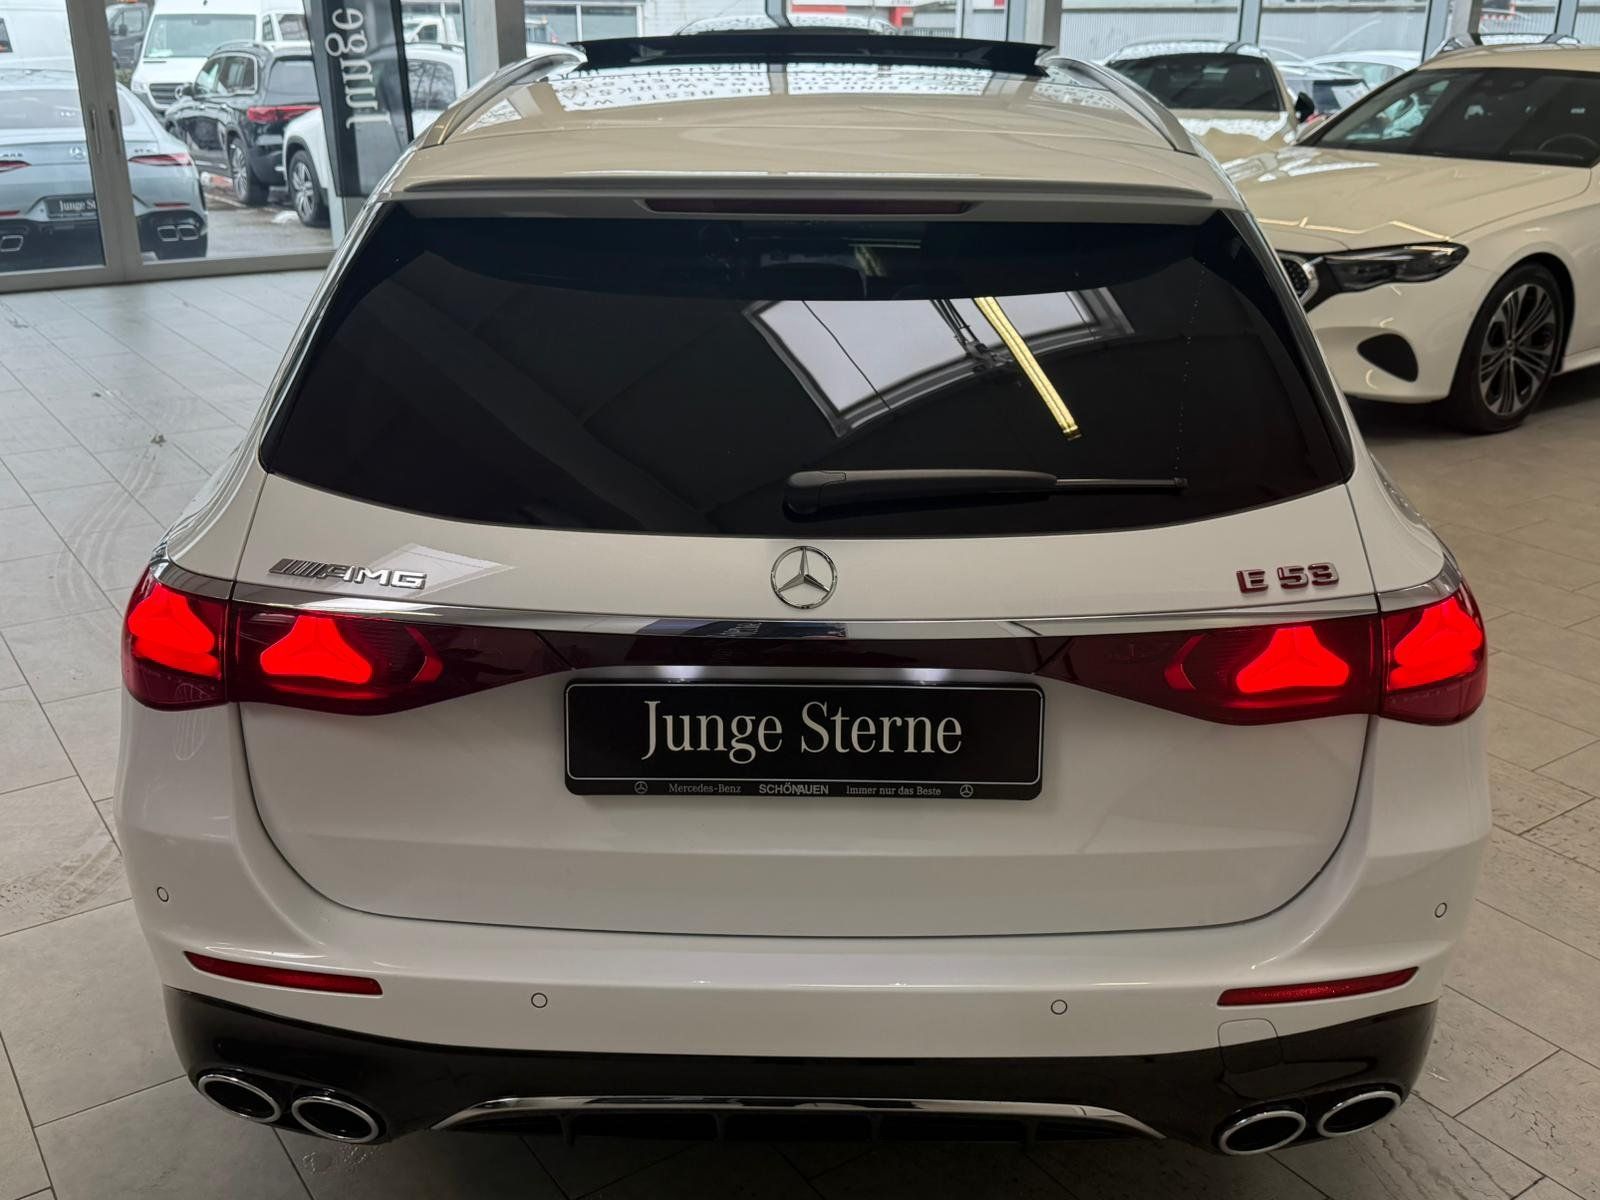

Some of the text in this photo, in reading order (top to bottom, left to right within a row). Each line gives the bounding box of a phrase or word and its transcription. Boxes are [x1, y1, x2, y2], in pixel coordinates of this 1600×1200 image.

[320, 563, 427, 590] AMG
[1236, 562, 1339, 593] E 53
[641, 700, 962, 764] Junge Sterne
[668, 783, 742, 794] Mercedes-Benz
[846, 785, 877, 795] Immer
[880, 787, 896, 796] nur
[898, 786, 914, 796] das
[917, 786, 942, 796] Beste
